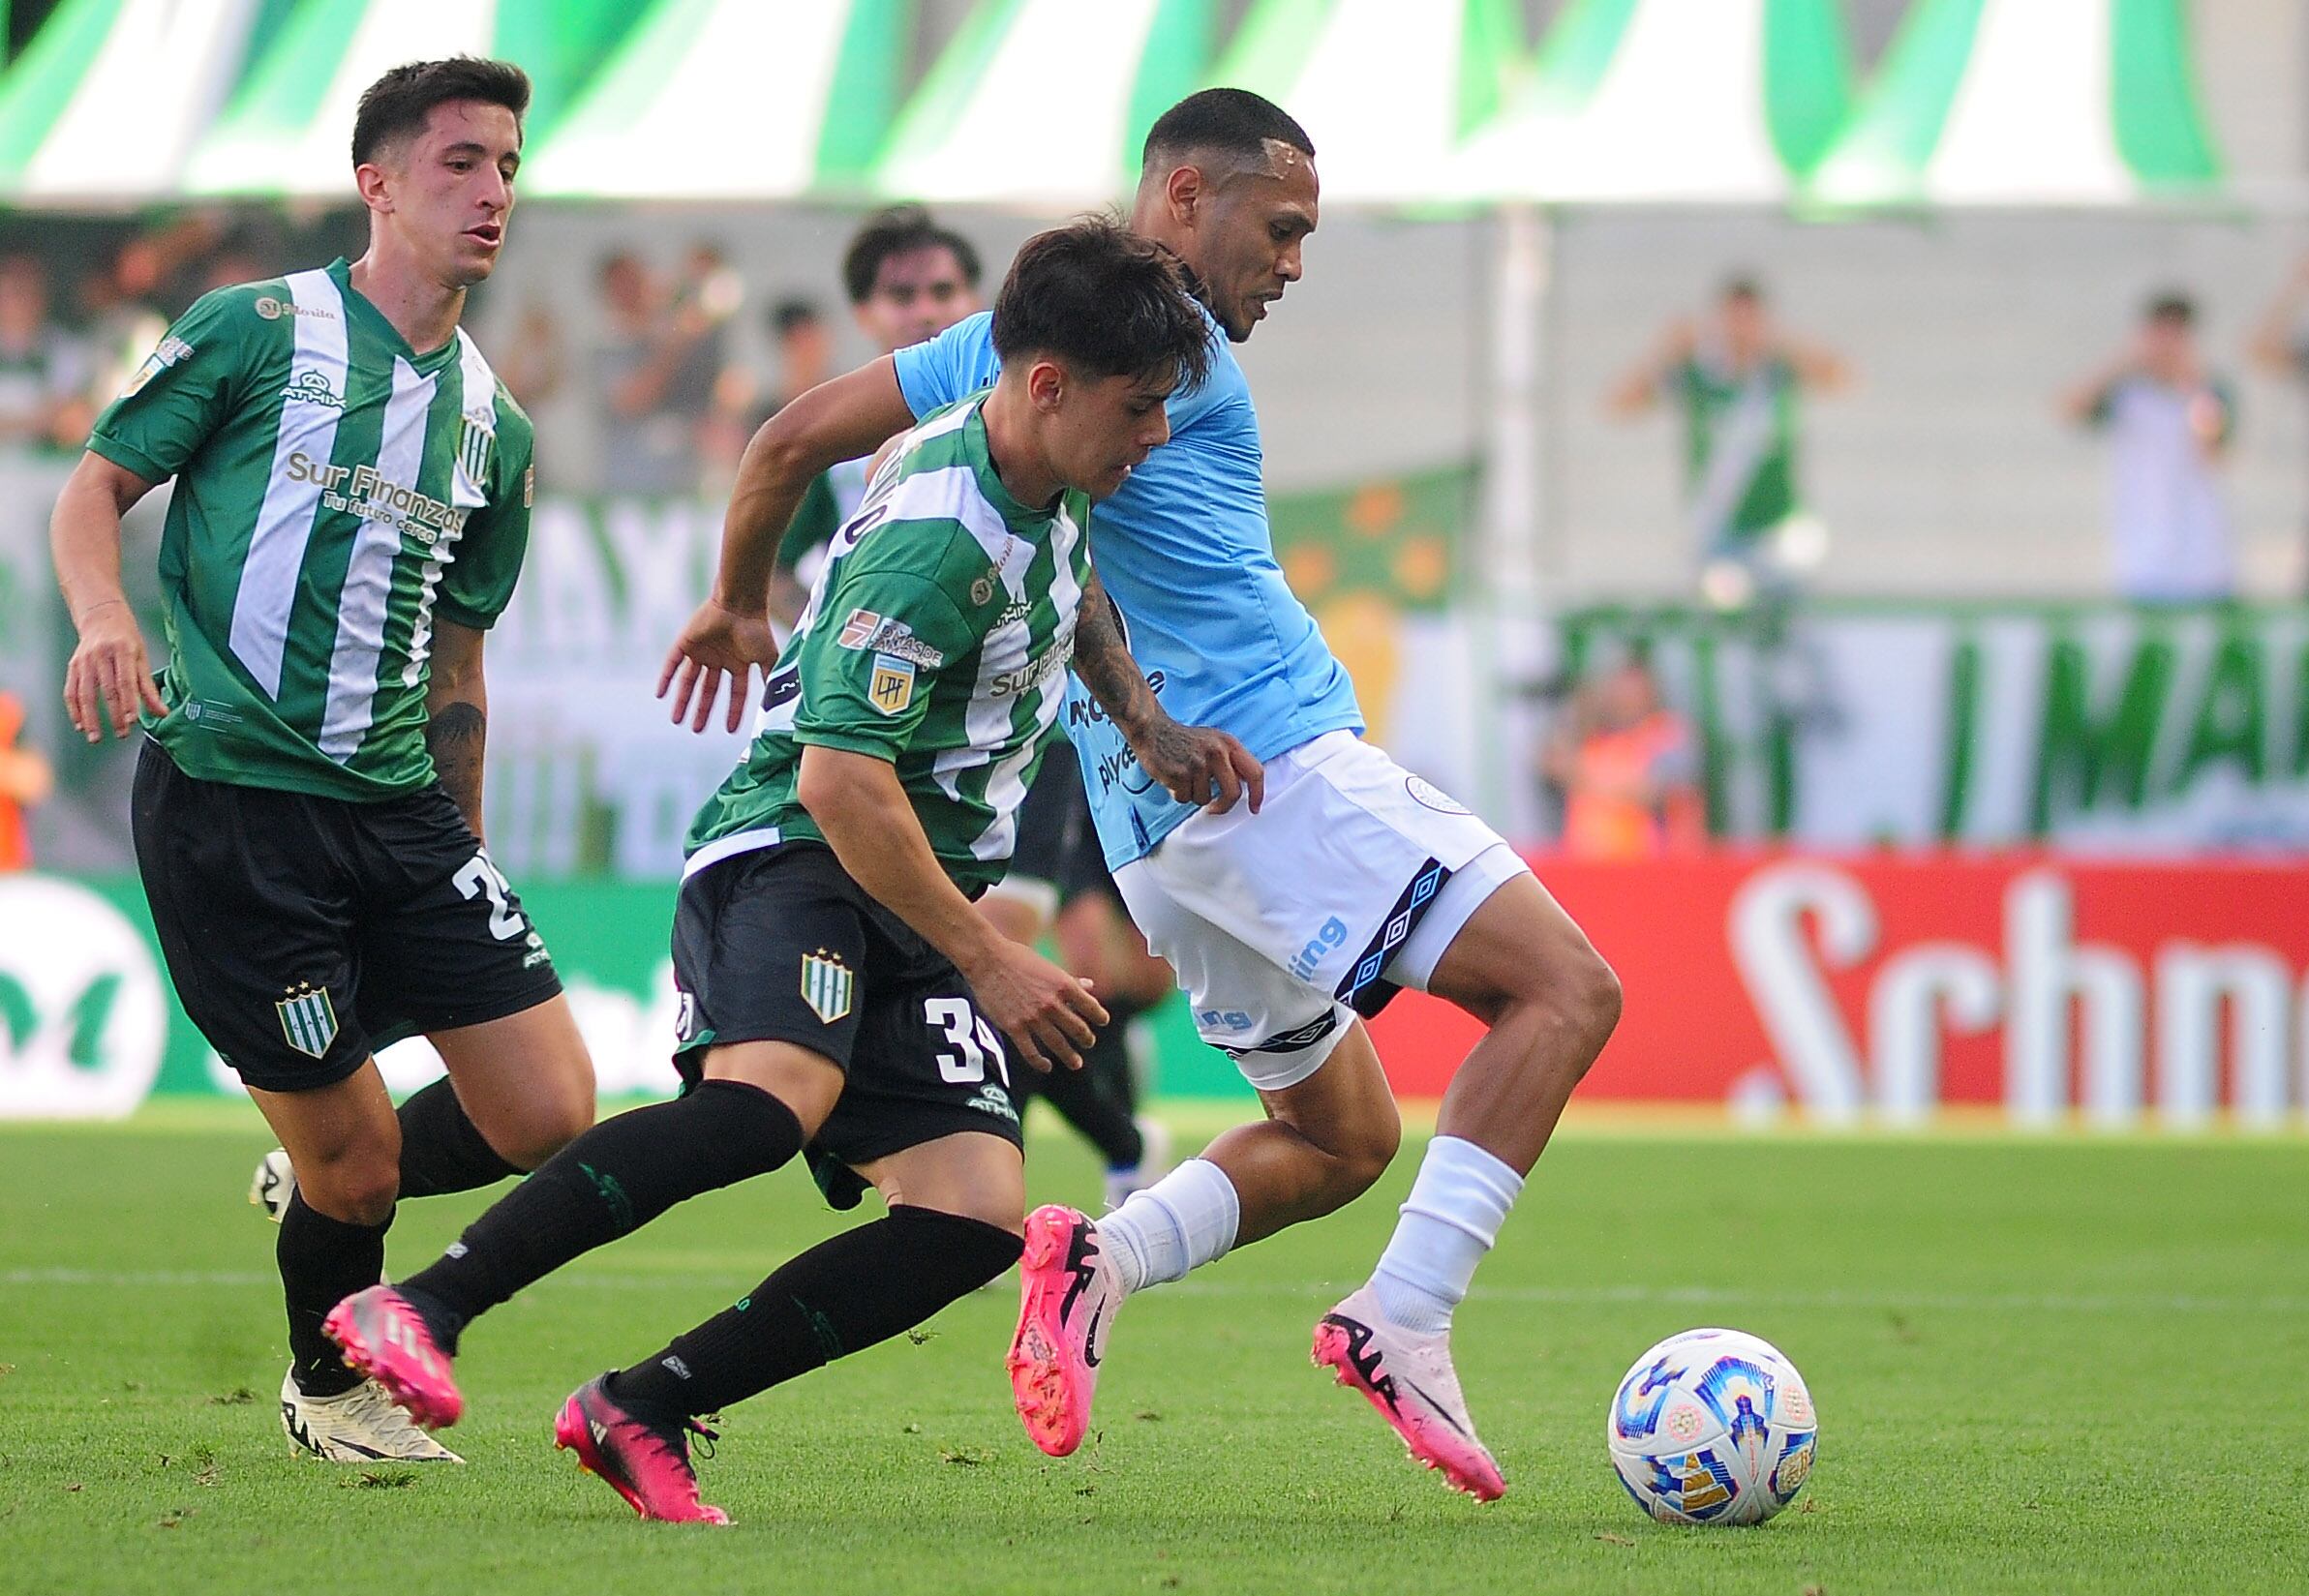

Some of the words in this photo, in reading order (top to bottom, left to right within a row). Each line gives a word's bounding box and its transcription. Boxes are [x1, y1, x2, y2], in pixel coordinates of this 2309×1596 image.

[279, 387, 347, 407] ATHIX
[287, 453, 349, 490] Sur
[349, 465, 463, 533] Finanzas
[323, 491, 346, 511] Tu
[349, 498, 393, 525] futuro
[396, 517, 439, 545] cerca
[990, 660, 1040, 698] Sur
[1098, 740, 1137, 796] plyce
[452, 847, 526, 941] 2
[1726, 858, 2309, 1134] Schn
